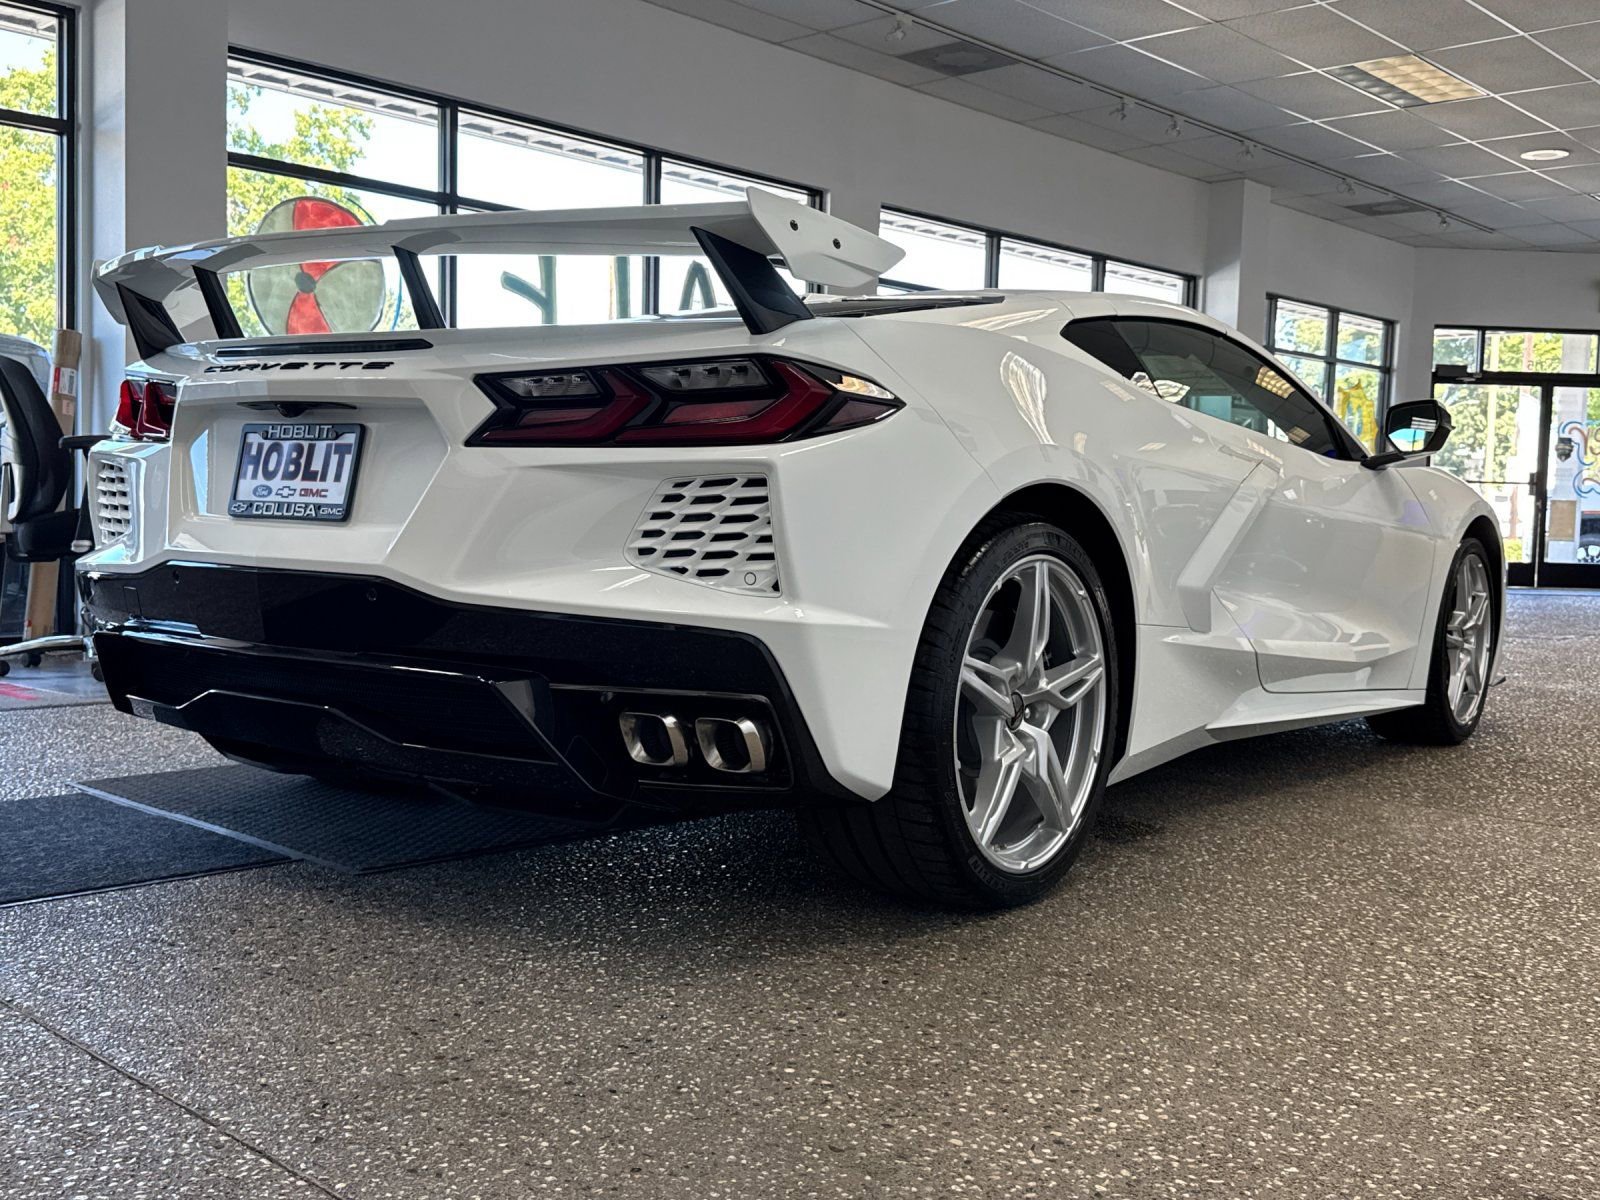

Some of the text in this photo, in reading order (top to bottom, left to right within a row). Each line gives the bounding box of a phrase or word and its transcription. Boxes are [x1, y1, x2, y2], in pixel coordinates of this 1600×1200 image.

[204, 361, 394, 373] CORVETTE
[267, 425, 332, 439] HOBLIT
[240, 441, 353, 483] HOBLIT
[299, 487, 329, 498] GMC
[252, 502, 344, 516] COLUSA GMC
